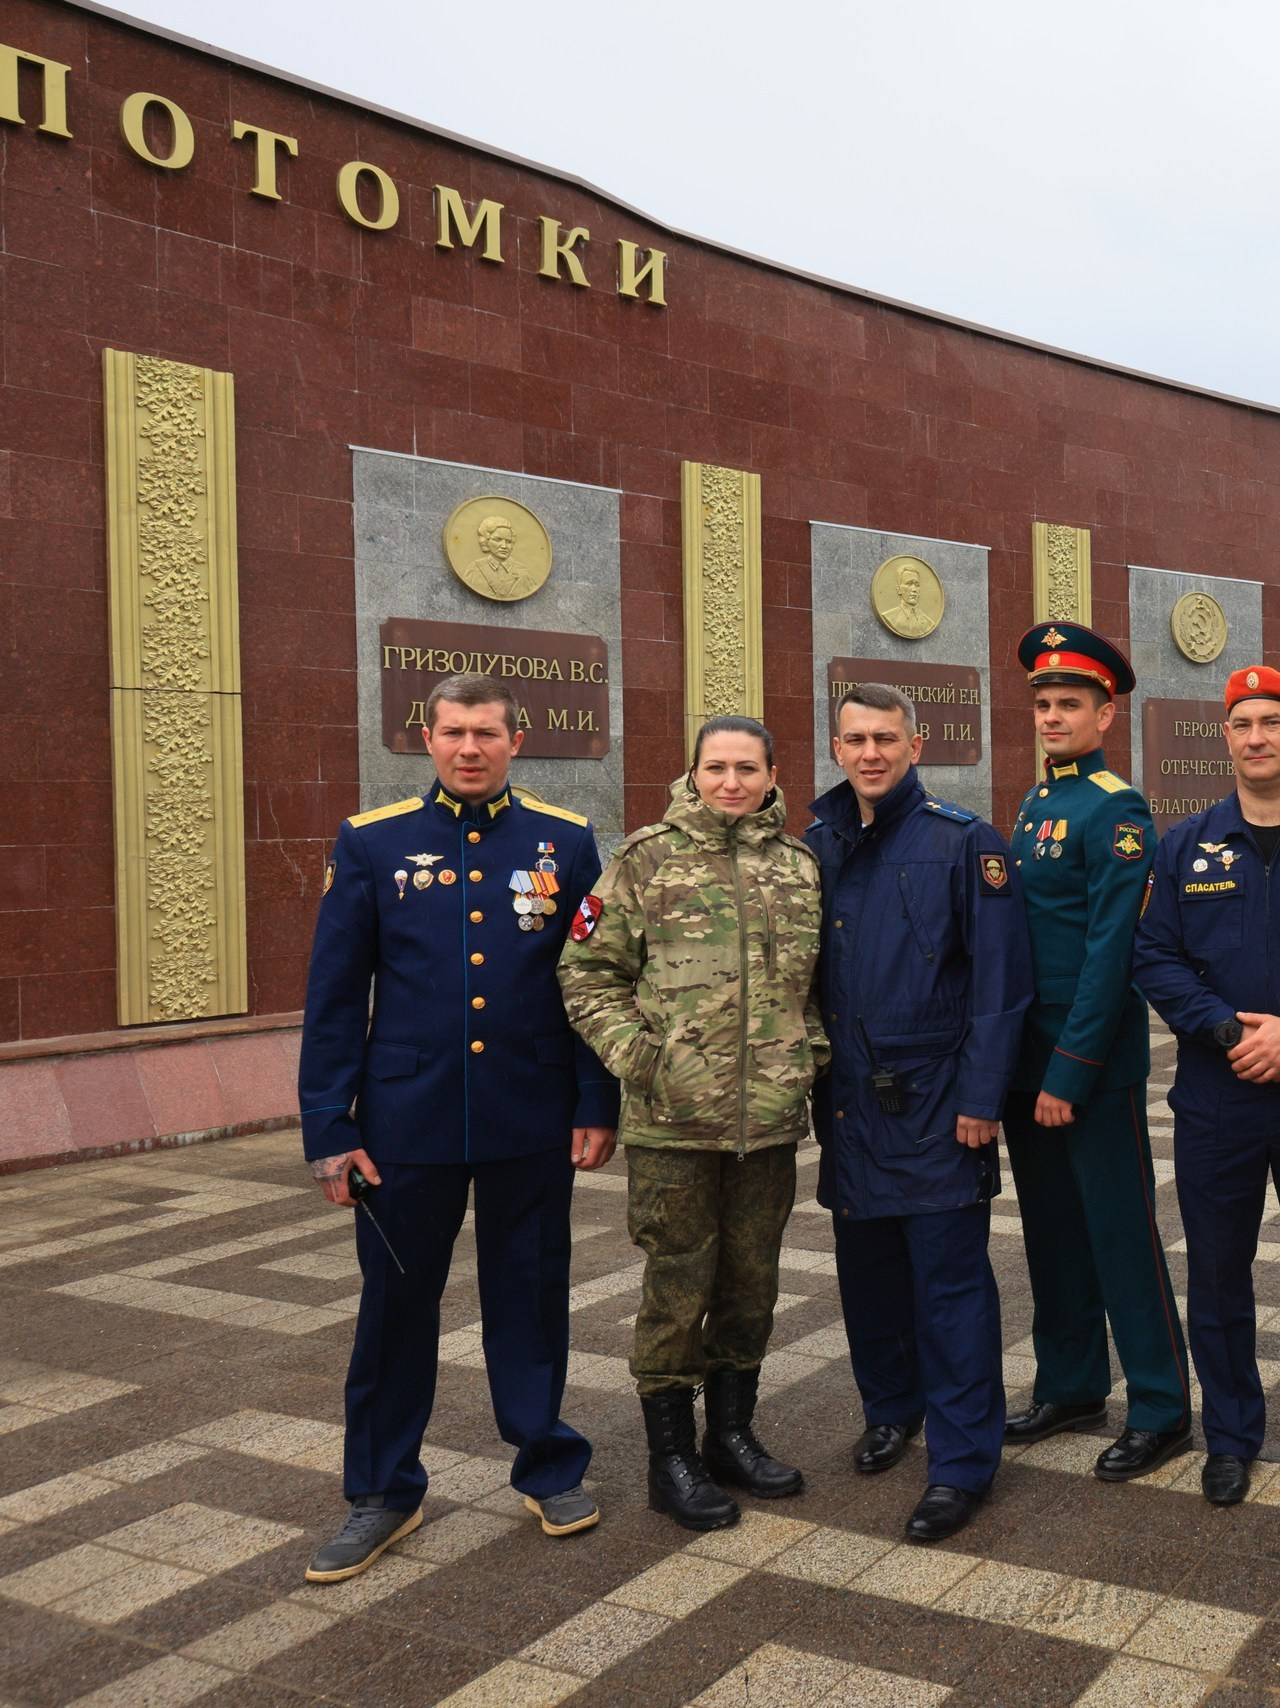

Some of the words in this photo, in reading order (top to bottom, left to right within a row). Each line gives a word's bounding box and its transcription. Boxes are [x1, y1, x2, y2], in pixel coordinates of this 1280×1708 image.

[0, 43, 668, 307] ПОТОМКИ
[383, 645, 563, 681] ГРИЗОДУБОВА
[569, 660, 609, 684] В.С.
[547, 708, 600, 732] М.И.
[943, 723, 975, 741] П.И.
[1161, 759, 1236, 776] ОТЕЧЕСТВ
[1185, 880, 1236, 893] СПАСАТЕЛЬ
